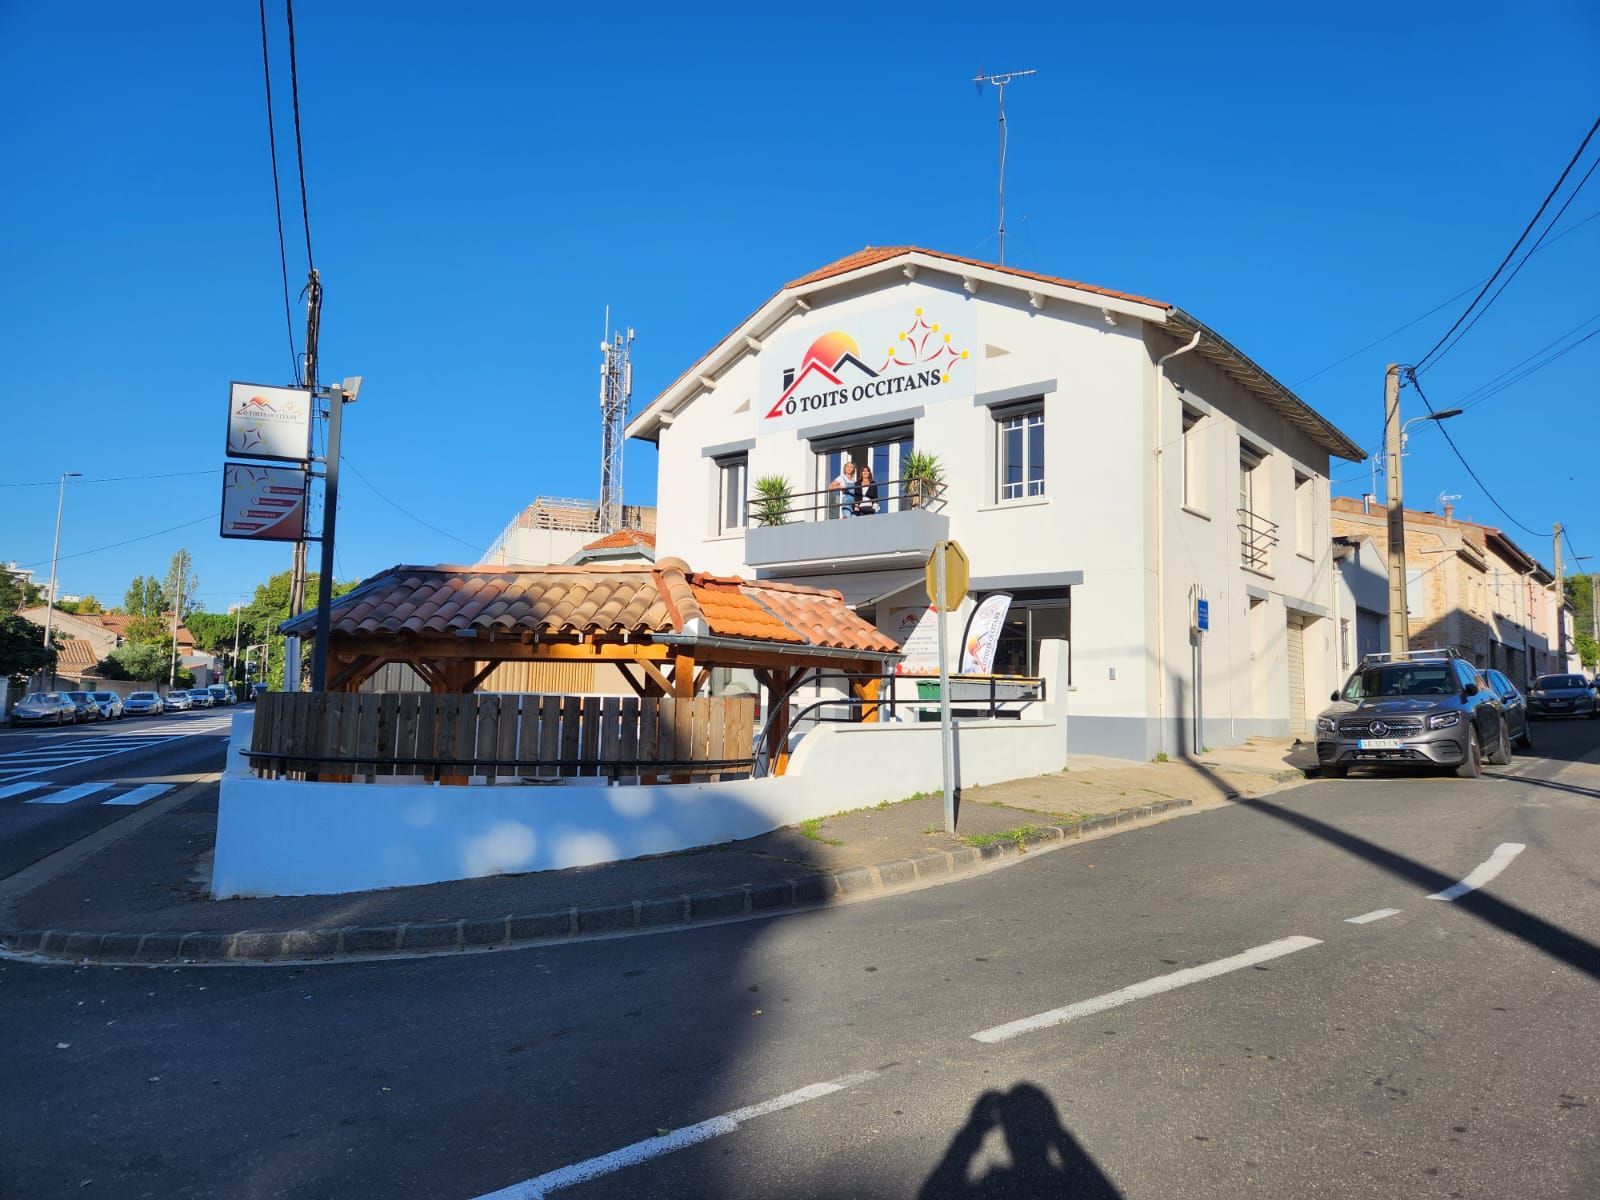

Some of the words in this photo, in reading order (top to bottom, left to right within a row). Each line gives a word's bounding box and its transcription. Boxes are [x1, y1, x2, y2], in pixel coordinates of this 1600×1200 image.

[785, 396, 797, 415] Ô
[800, 389, 848, 412] TOITS
[852, 369, 941, 401] OCCITANS
